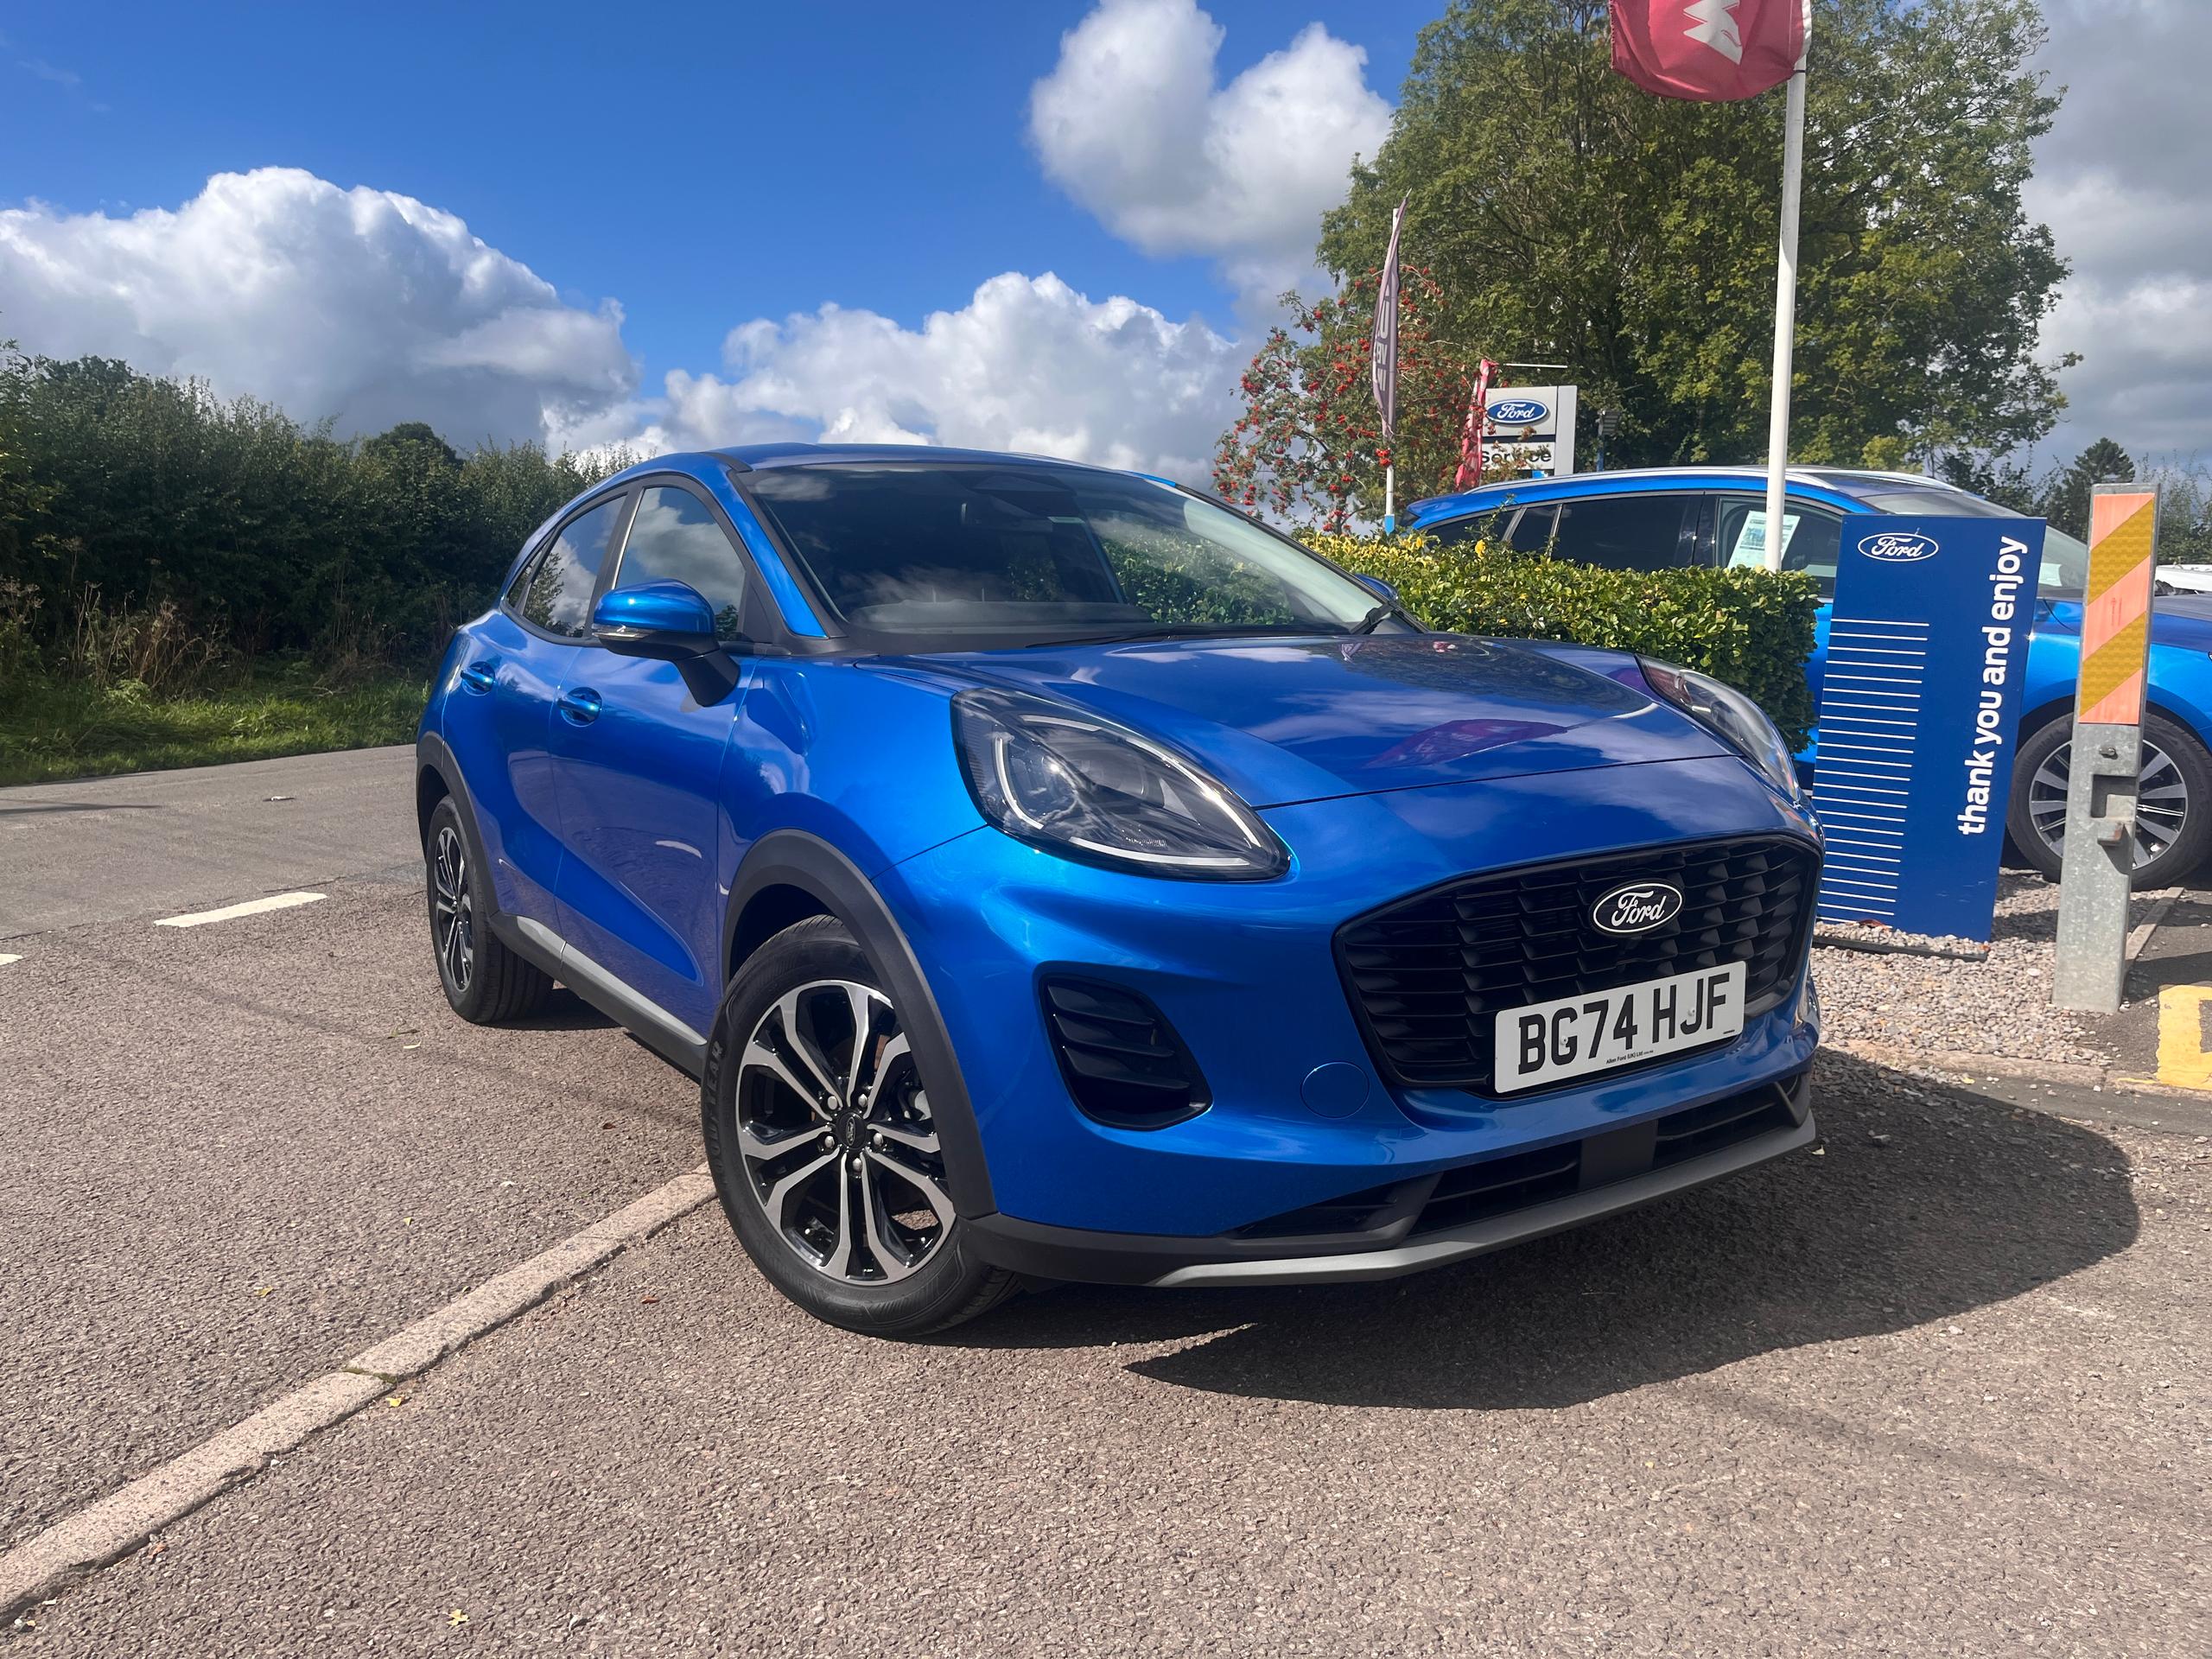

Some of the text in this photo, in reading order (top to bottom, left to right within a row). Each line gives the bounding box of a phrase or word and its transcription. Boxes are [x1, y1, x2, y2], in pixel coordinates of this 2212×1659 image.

[1497, 403, 1535, 419] Ford
[1482, 451, 1552, 463] Serce
[1871, 536, 1925, 557] Ford
[1957, 536, 2028, 836] thank you and enjoy
[1611, 890, 1667, 927] Ford
[1518, 972, 1731, 1075] BG74 HJF
